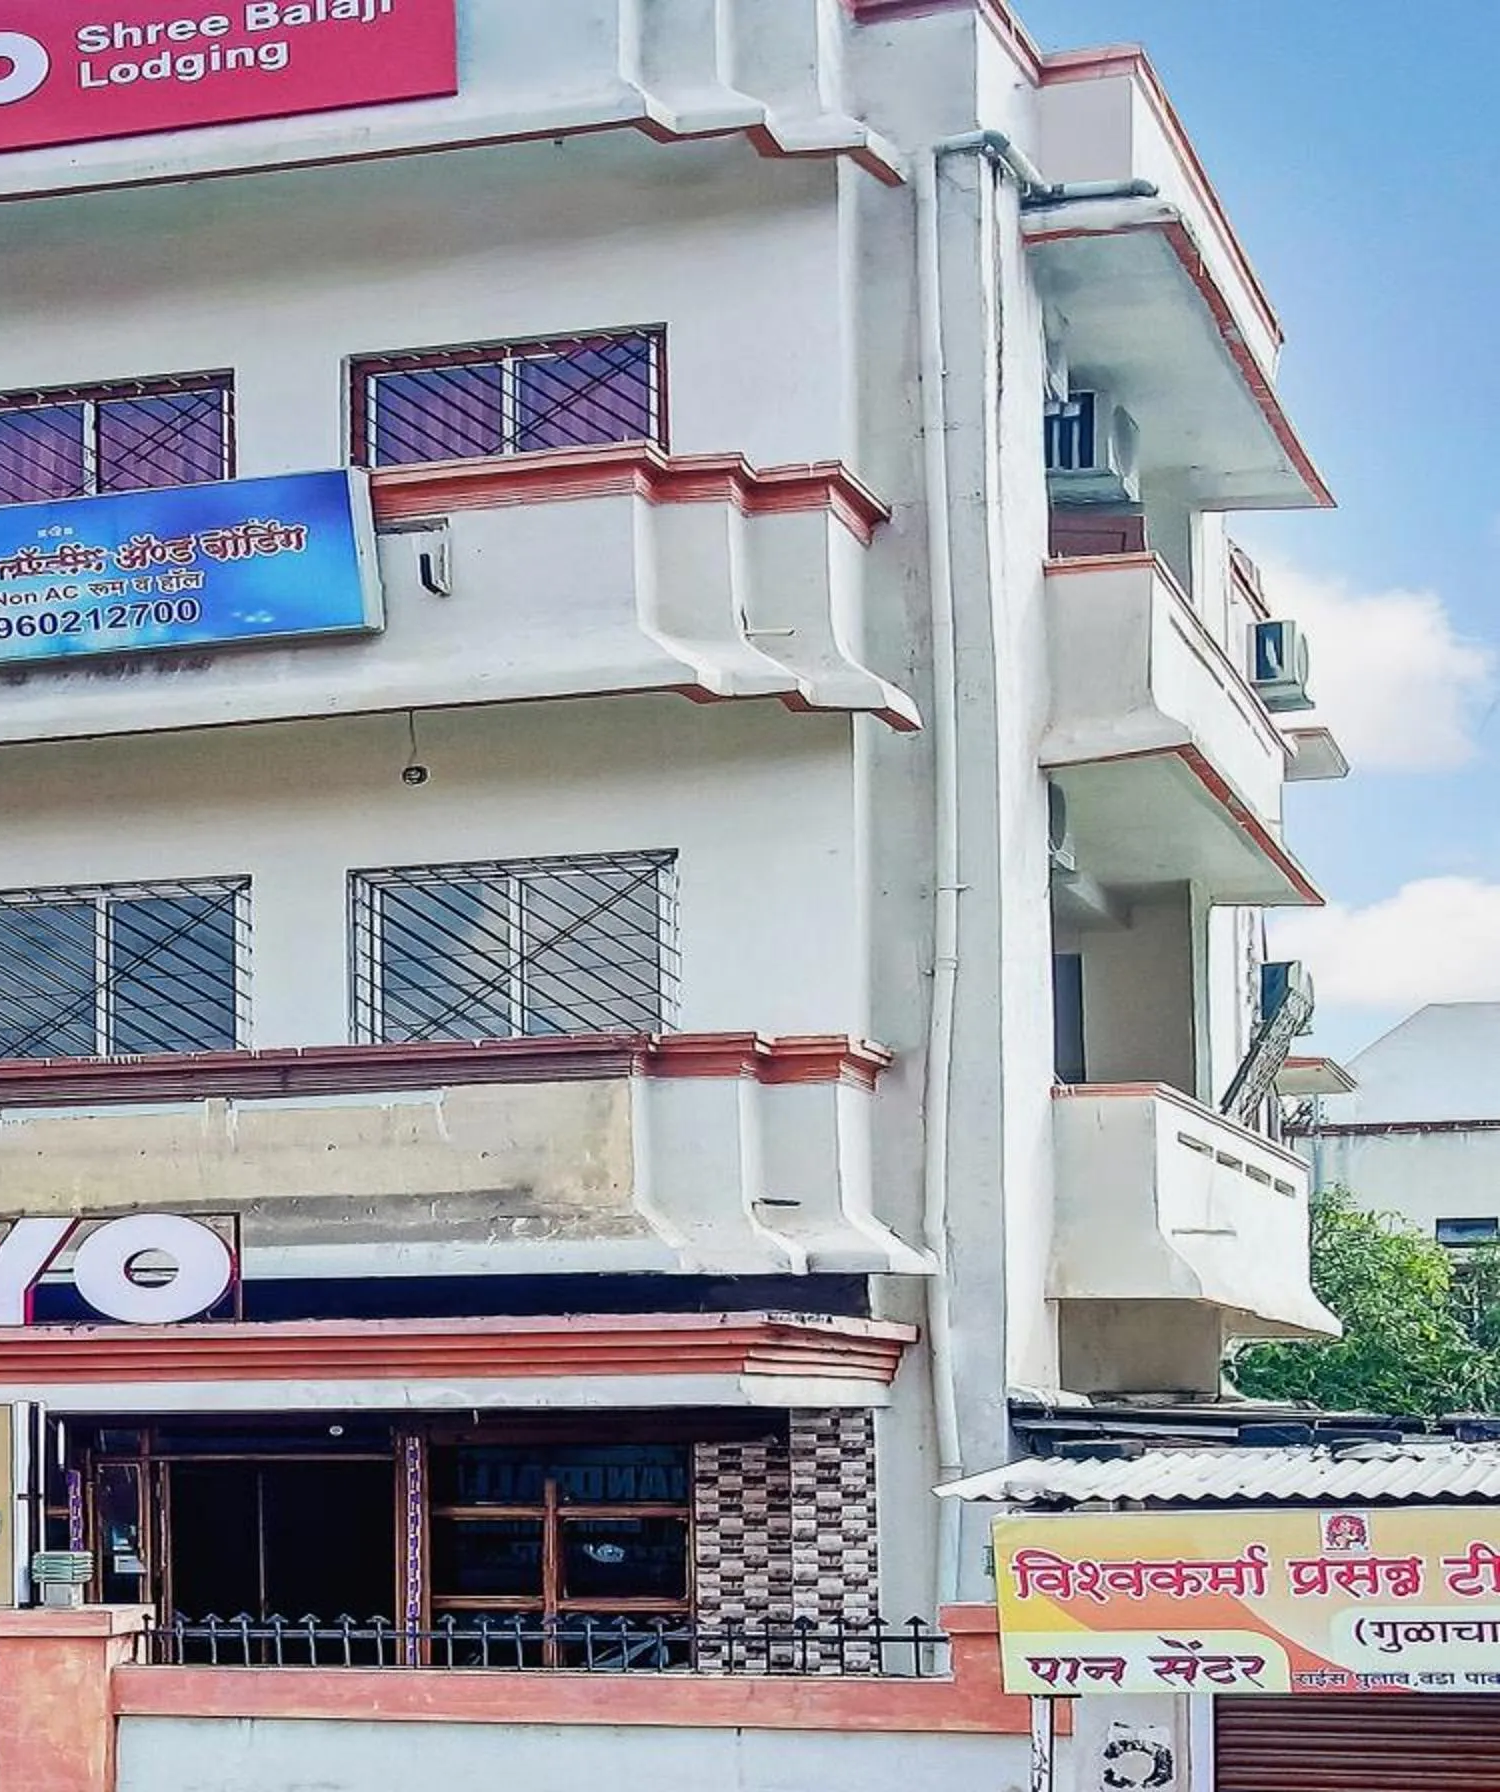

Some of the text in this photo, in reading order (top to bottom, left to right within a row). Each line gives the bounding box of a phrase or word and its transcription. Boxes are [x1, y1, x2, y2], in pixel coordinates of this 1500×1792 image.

[77, 14, 230, 53] Shree
[79, 40, 289, 88] Lodging
[45, 585, 78, 601] AC
[88, 579, 126, 596] रूम
[134, 576, 150, 592] व
[158, 569, 203, 593] हॉल
[1012, 1544, 1268, 1602] विश्वकर्मा
[1285, 1556, 1426, 1598] प्रसन्न
[1025, 1636, 1266, 1688] पान सेंटर
